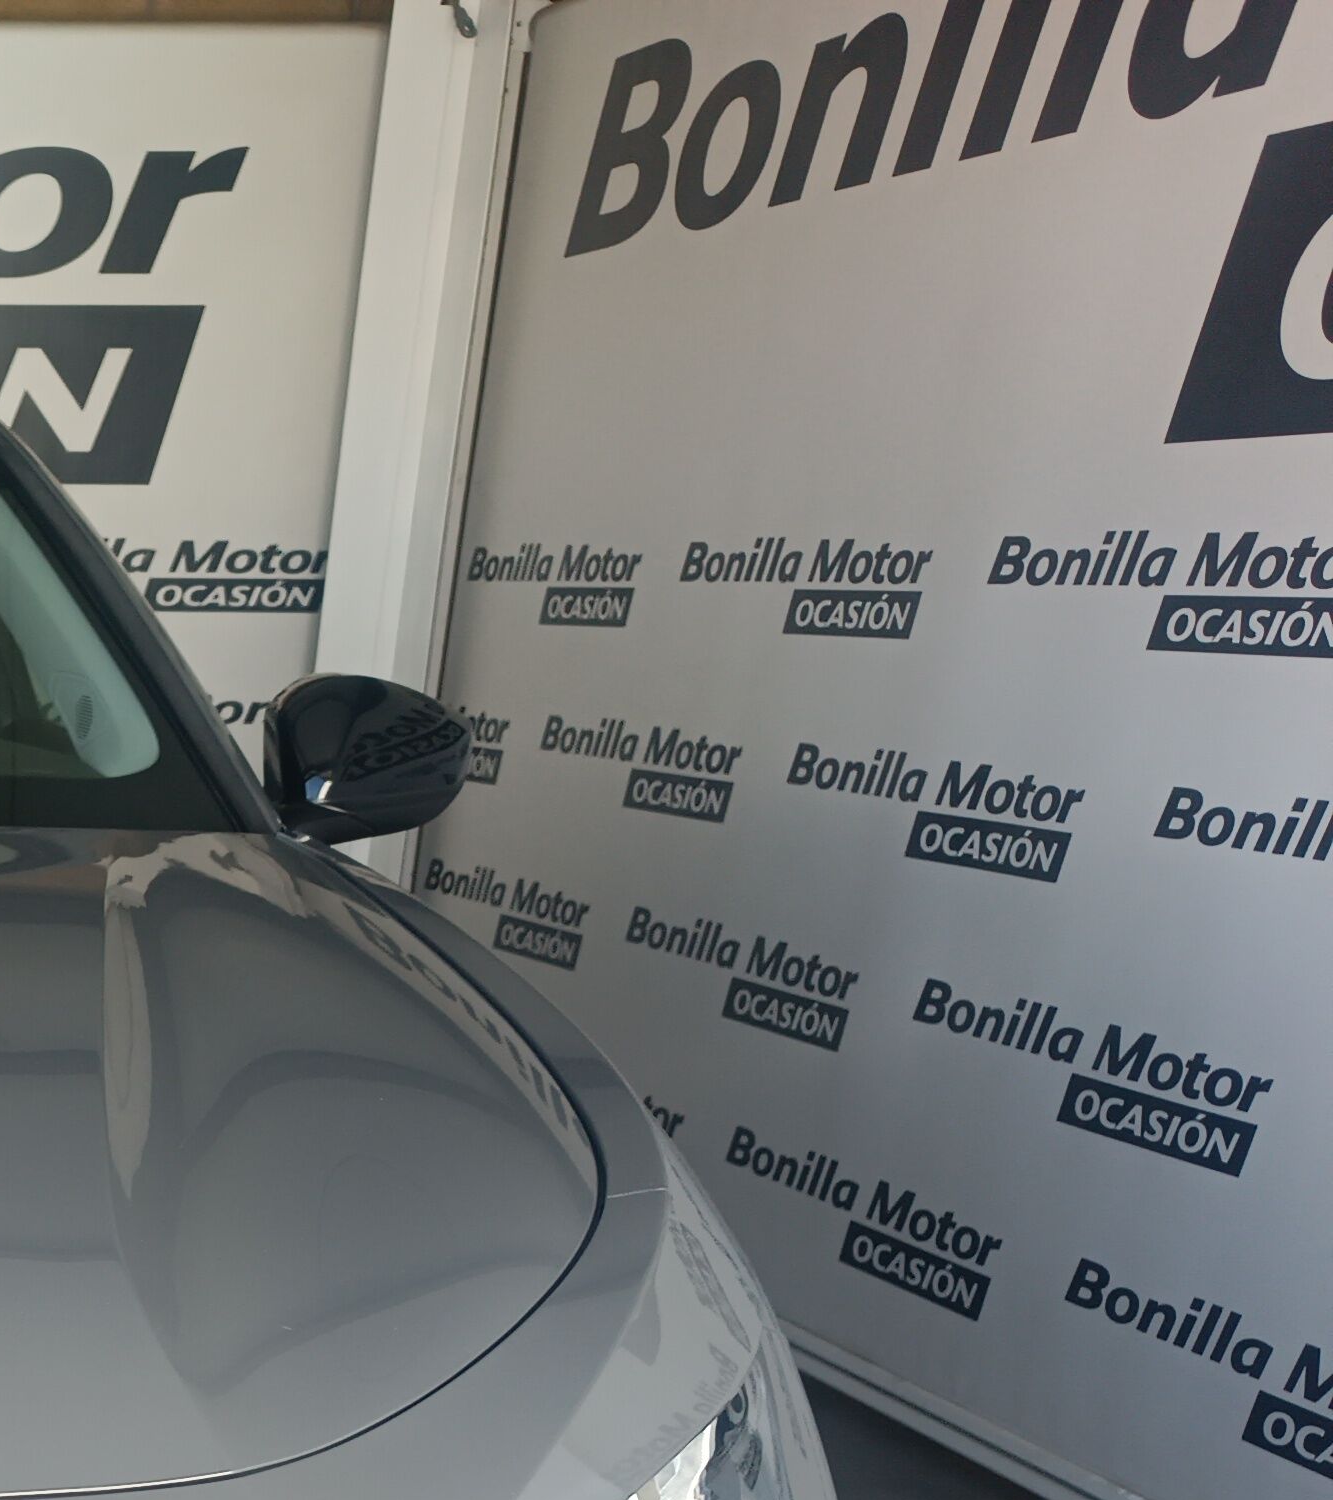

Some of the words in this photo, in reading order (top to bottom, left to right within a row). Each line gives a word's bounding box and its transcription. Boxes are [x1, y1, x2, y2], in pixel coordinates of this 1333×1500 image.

[169, 540, 328, 575] Motor
[467, 543, 551, 583] Bonilla
[556, 544, 643, 583] Motor
[679, 537, 801, 585] Bonilla
[808, 539, 933, 586] Motor
[986, 530, 1177, 587] Bonilla
[155, 580, 315, 609] OCASIÓN
[547, 587, 625, 620] OCASIÓN
[794, 592, 912, 631] OCASIÓN
[541, 715, 638, 766] Bonilla
[643, 726, 742, 776] Motor
[632, 772, 726, 816] OCASIÓN
[786, 742, 928, 803] Bonilla
[934, 760, 1086, 824] Motor
[919, 819, 1058, 874] OCASIÓN
[424, 858, 506, 907] Bonilla
[508, 878, 590, 927] Motor
[500, 922, 578, 963] OCASIÓN
[625, 906, 739, 970] Bonilla
[744, 934, 859, 1001] Motor
[732, 987, 840, 1045] OCASIÓN
[912, 978, 1085, 1065] Bonilla
[1091, 1024, 1274, 1114] Motor
[1073, 1087, 1241, 1167] OCASIÓN
[725, 1127, 860, 1211] Bonilla
[866, 1180, 1003, 1266] Motor
[851, 1232, 983, 1311] OCASIÓN
[1064, 1257, 1274, 1380] Bonilla
